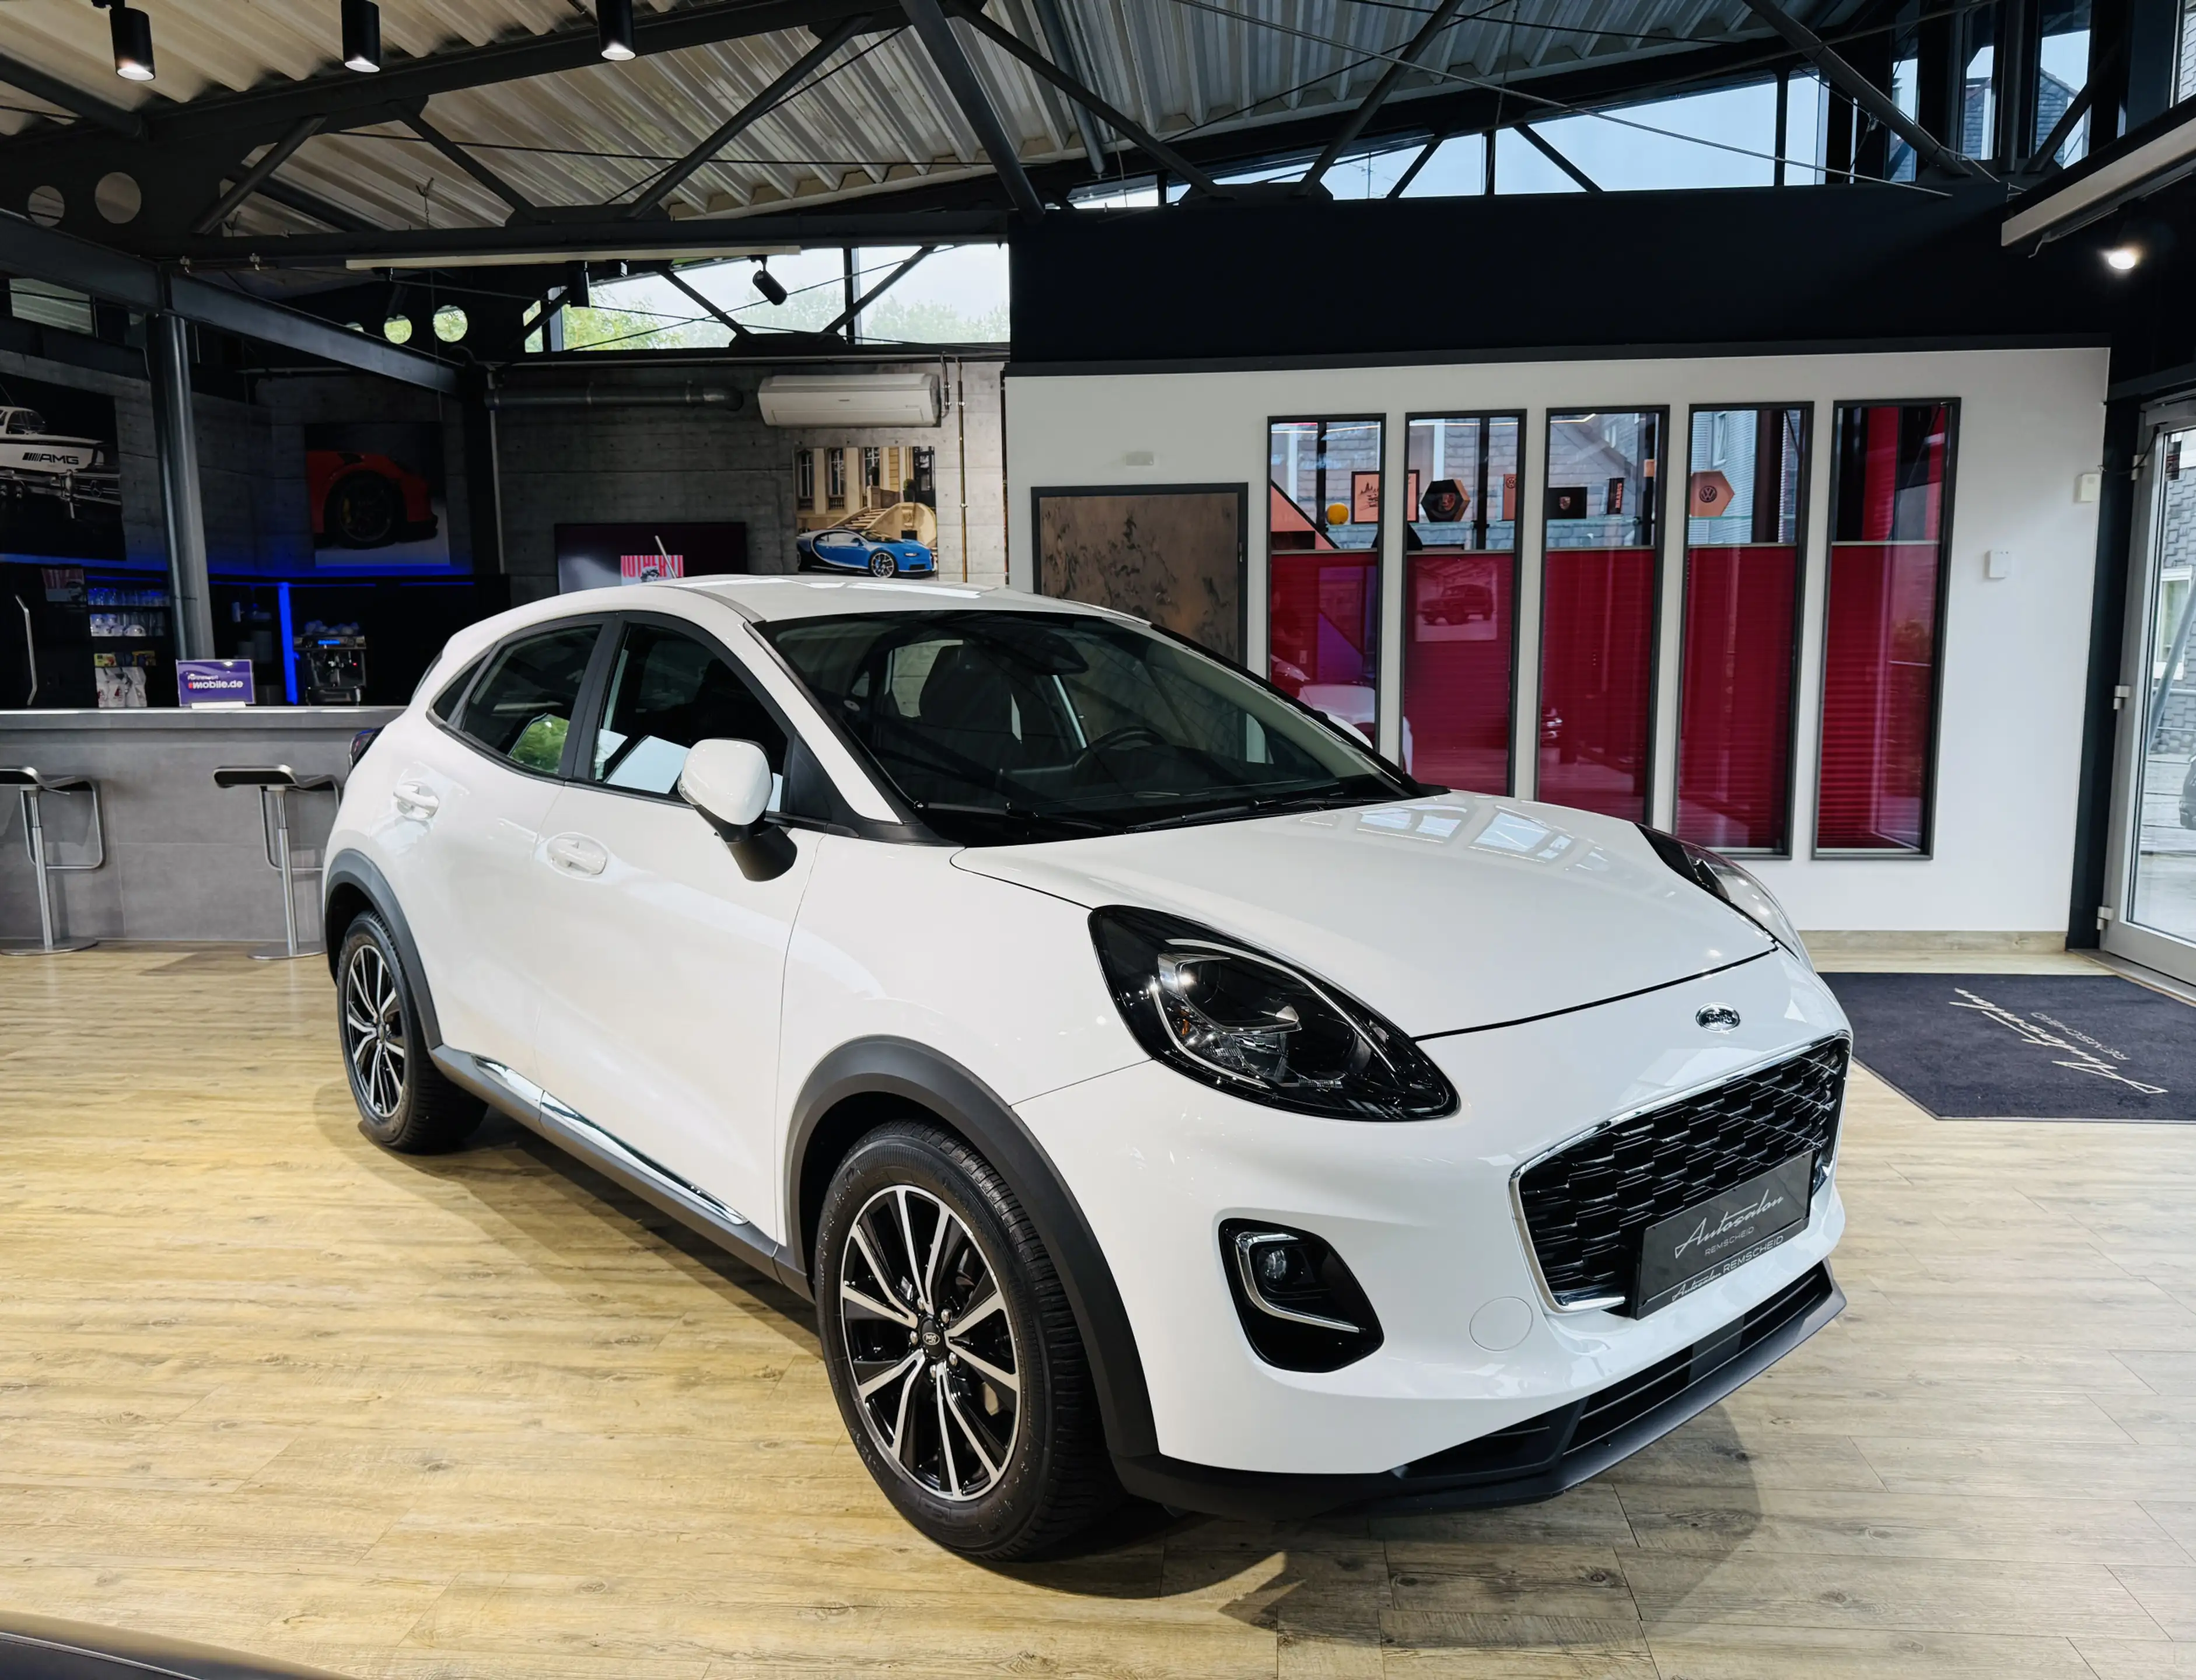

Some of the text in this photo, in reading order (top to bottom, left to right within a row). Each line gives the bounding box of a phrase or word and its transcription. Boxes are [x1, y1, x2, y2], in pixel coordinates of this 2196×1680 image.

[40, 453, 79, 465] AMG
[193, 680, 244, 690] mobile.de
[1674, 1189, 1784, 1259] Autosalon
[1704, 1226, 1754, 1256] REMSCHEID
[1723, 1235, 1784, 1274] REMSCHEID
